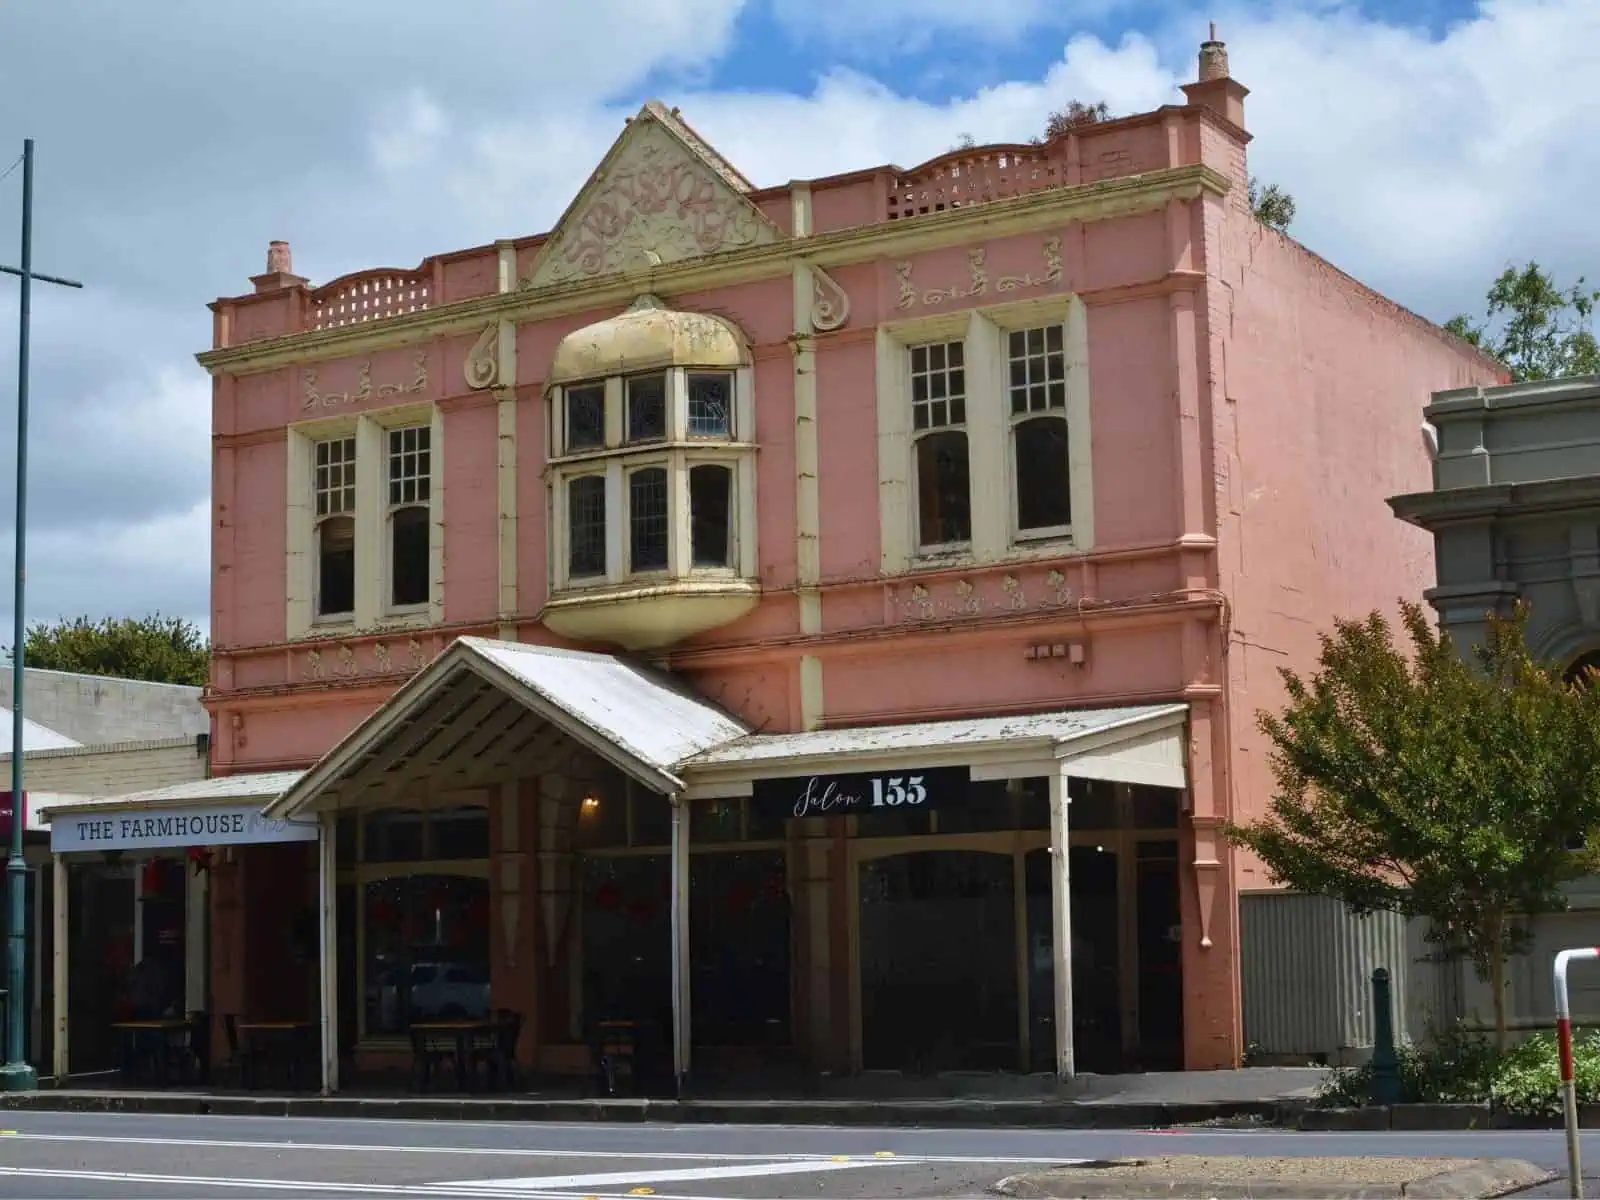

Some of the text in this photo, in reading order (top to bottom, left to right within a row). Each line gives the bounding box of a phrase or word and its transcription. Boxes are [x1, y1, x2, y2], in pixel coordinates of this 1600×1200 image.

[793, 776, 928, 817] Salon 155
[77, 821, 114, 841] THE
[120, 814, 244, 839] FARMHOUSE
